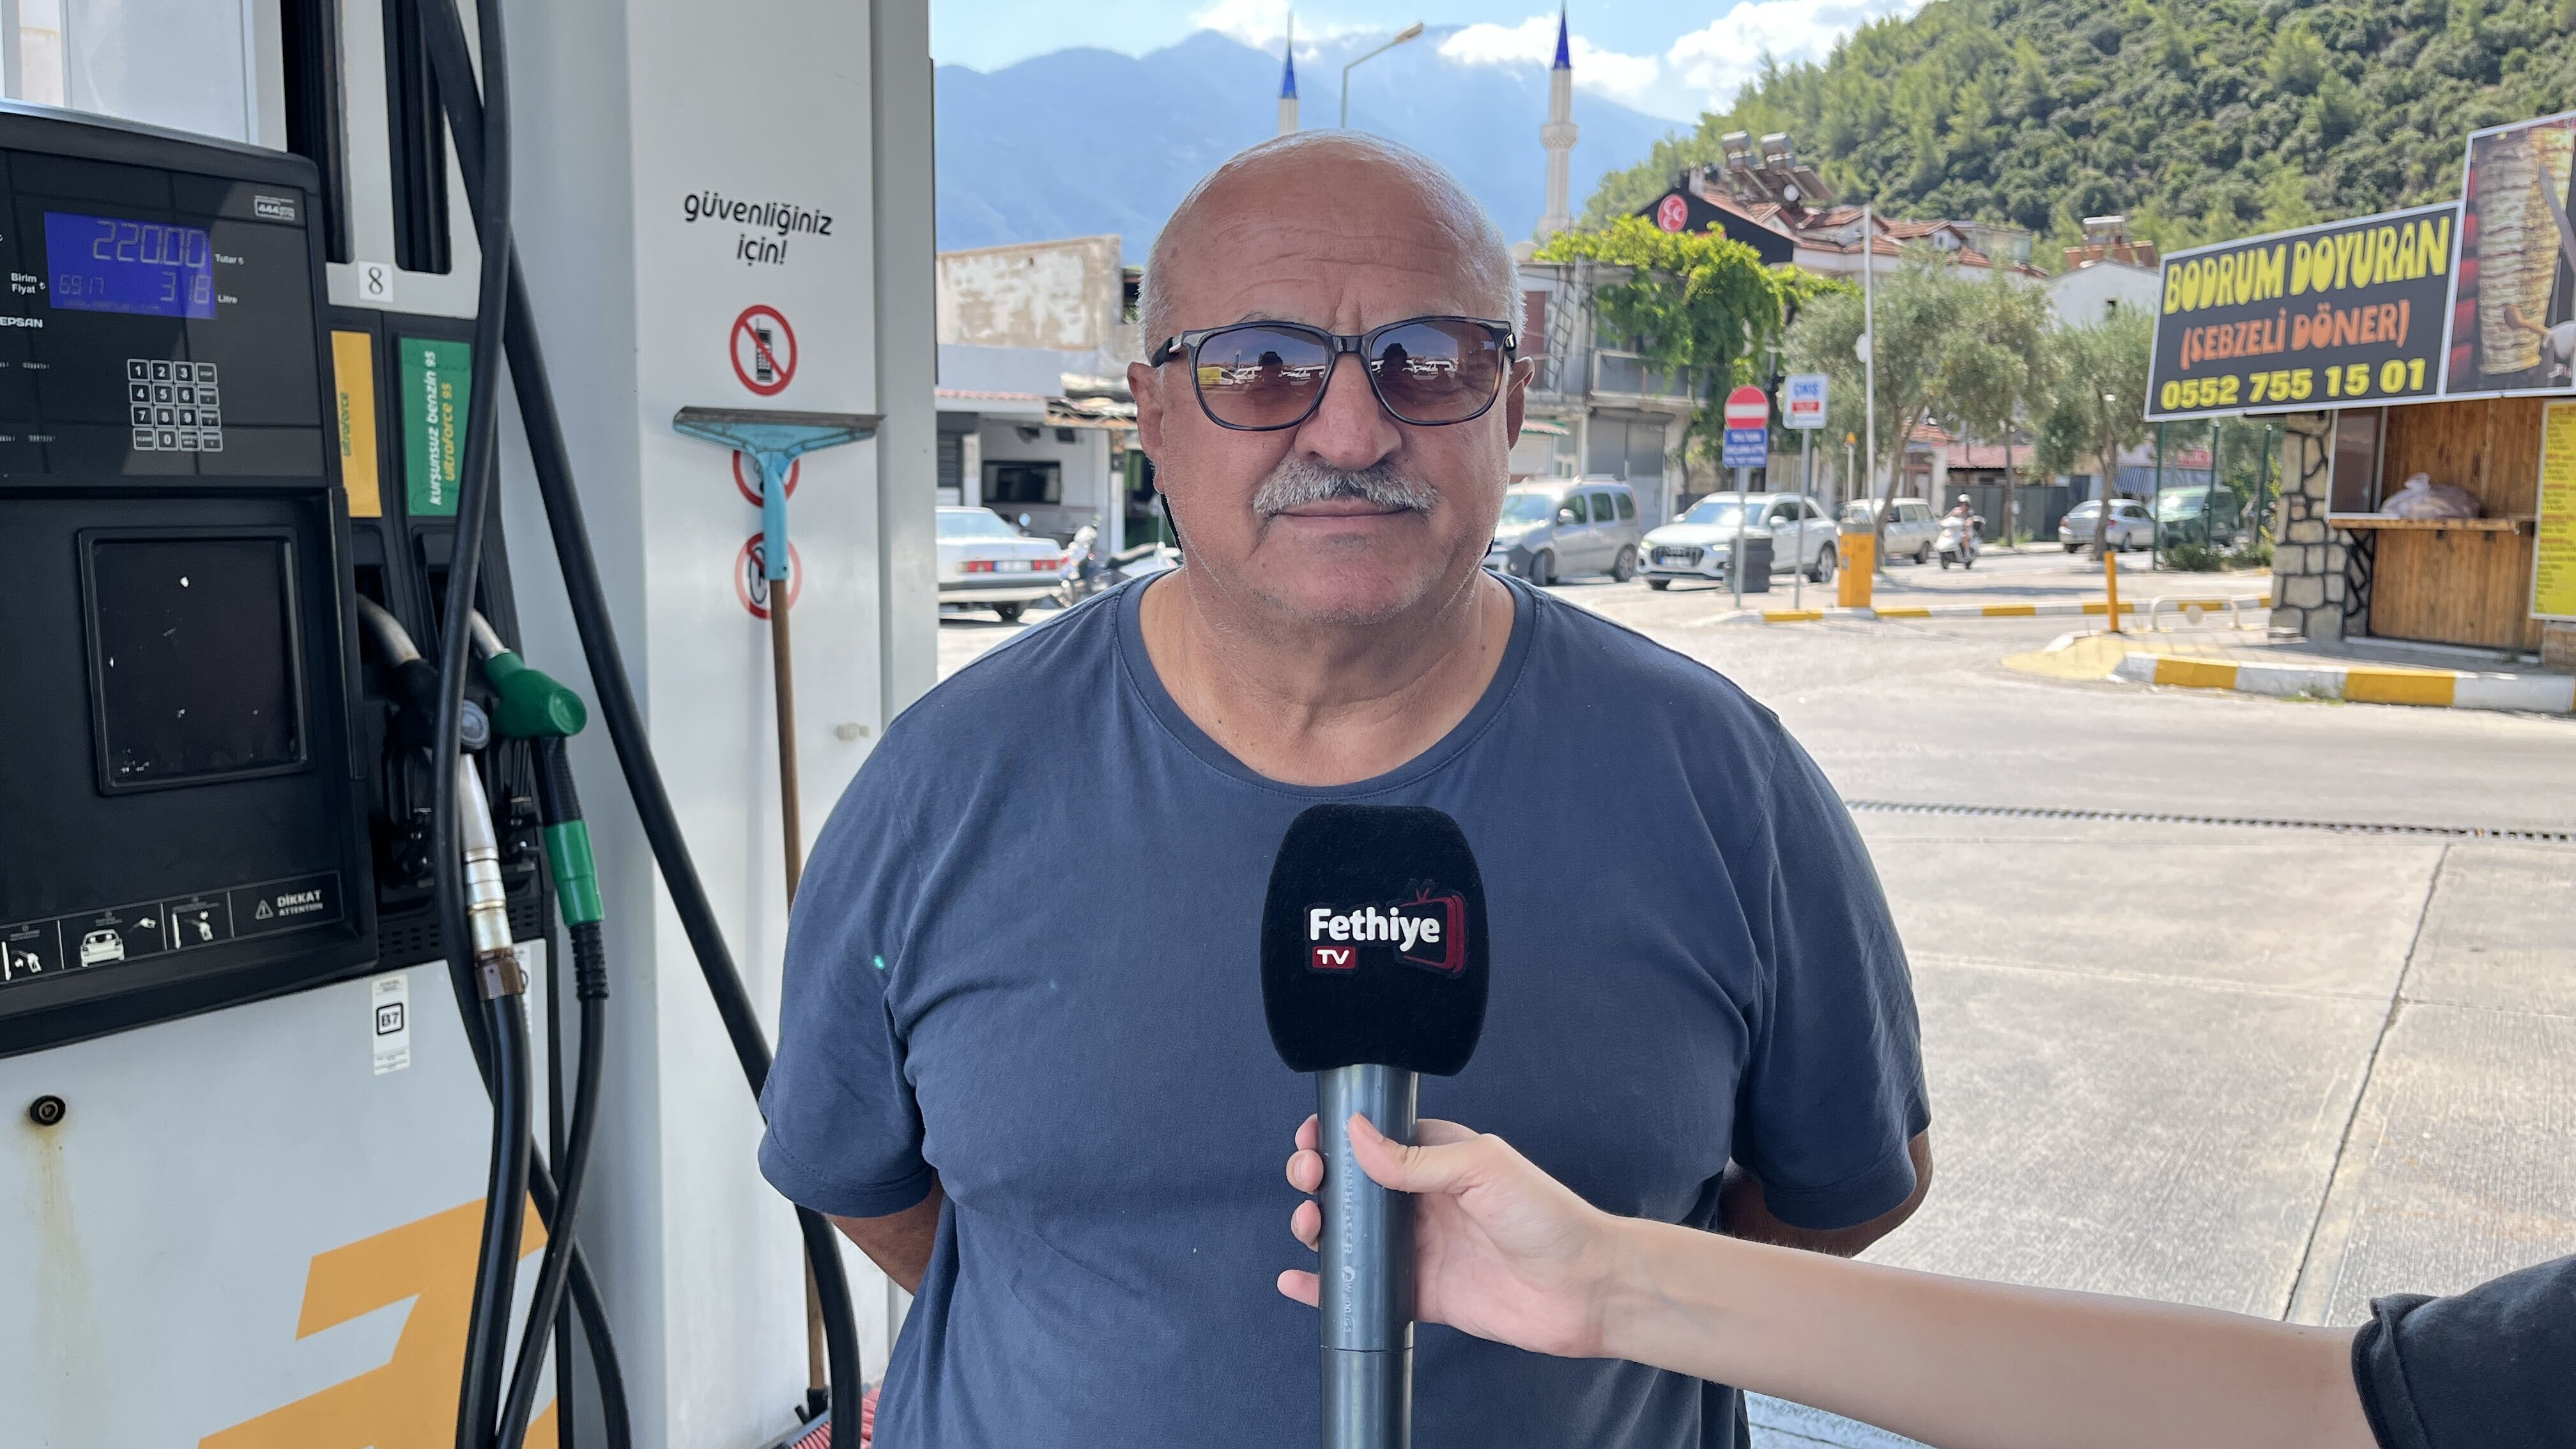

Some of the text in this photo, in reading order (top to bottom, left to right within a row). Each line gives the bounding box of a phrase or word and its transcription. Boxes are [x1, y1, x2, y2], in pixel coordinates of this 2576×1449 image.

[684, 190, 832, 236] güvenliğiniz
[737, 233, 788, 266] için!
[2163, 215, 2451, 315] BODRUM DOYURAN
[11, 273, 37, 283] Birim
[12, 284, 36, 295] Fiyat
[368, 266, 383, 295] 8
[2180, 299, 2411, 371] (SEBZELİ DÖNER)
[424, 350, 437, 368] 95
[135, 365, 141, 376] 1
[158, 366, 165, 378] 2
[180, 367, 188, 378] 3
[137, 388, 145, 399] 4
[160, 388, 167, 401] 5
[2160, 358, 2426, 410] 0552 755 15 01
[424, 372, 438, 424] benzin
[137, 410, 146, 422] 7
[164, 434, 171, 445] 0
[441, 381, 456, 482] ultraforce 95
[277, 889, 321, 908] DİKKAT
[1310, 907, 1440, 952] Fethiye
[1316, 949, 1350, 965] TV
